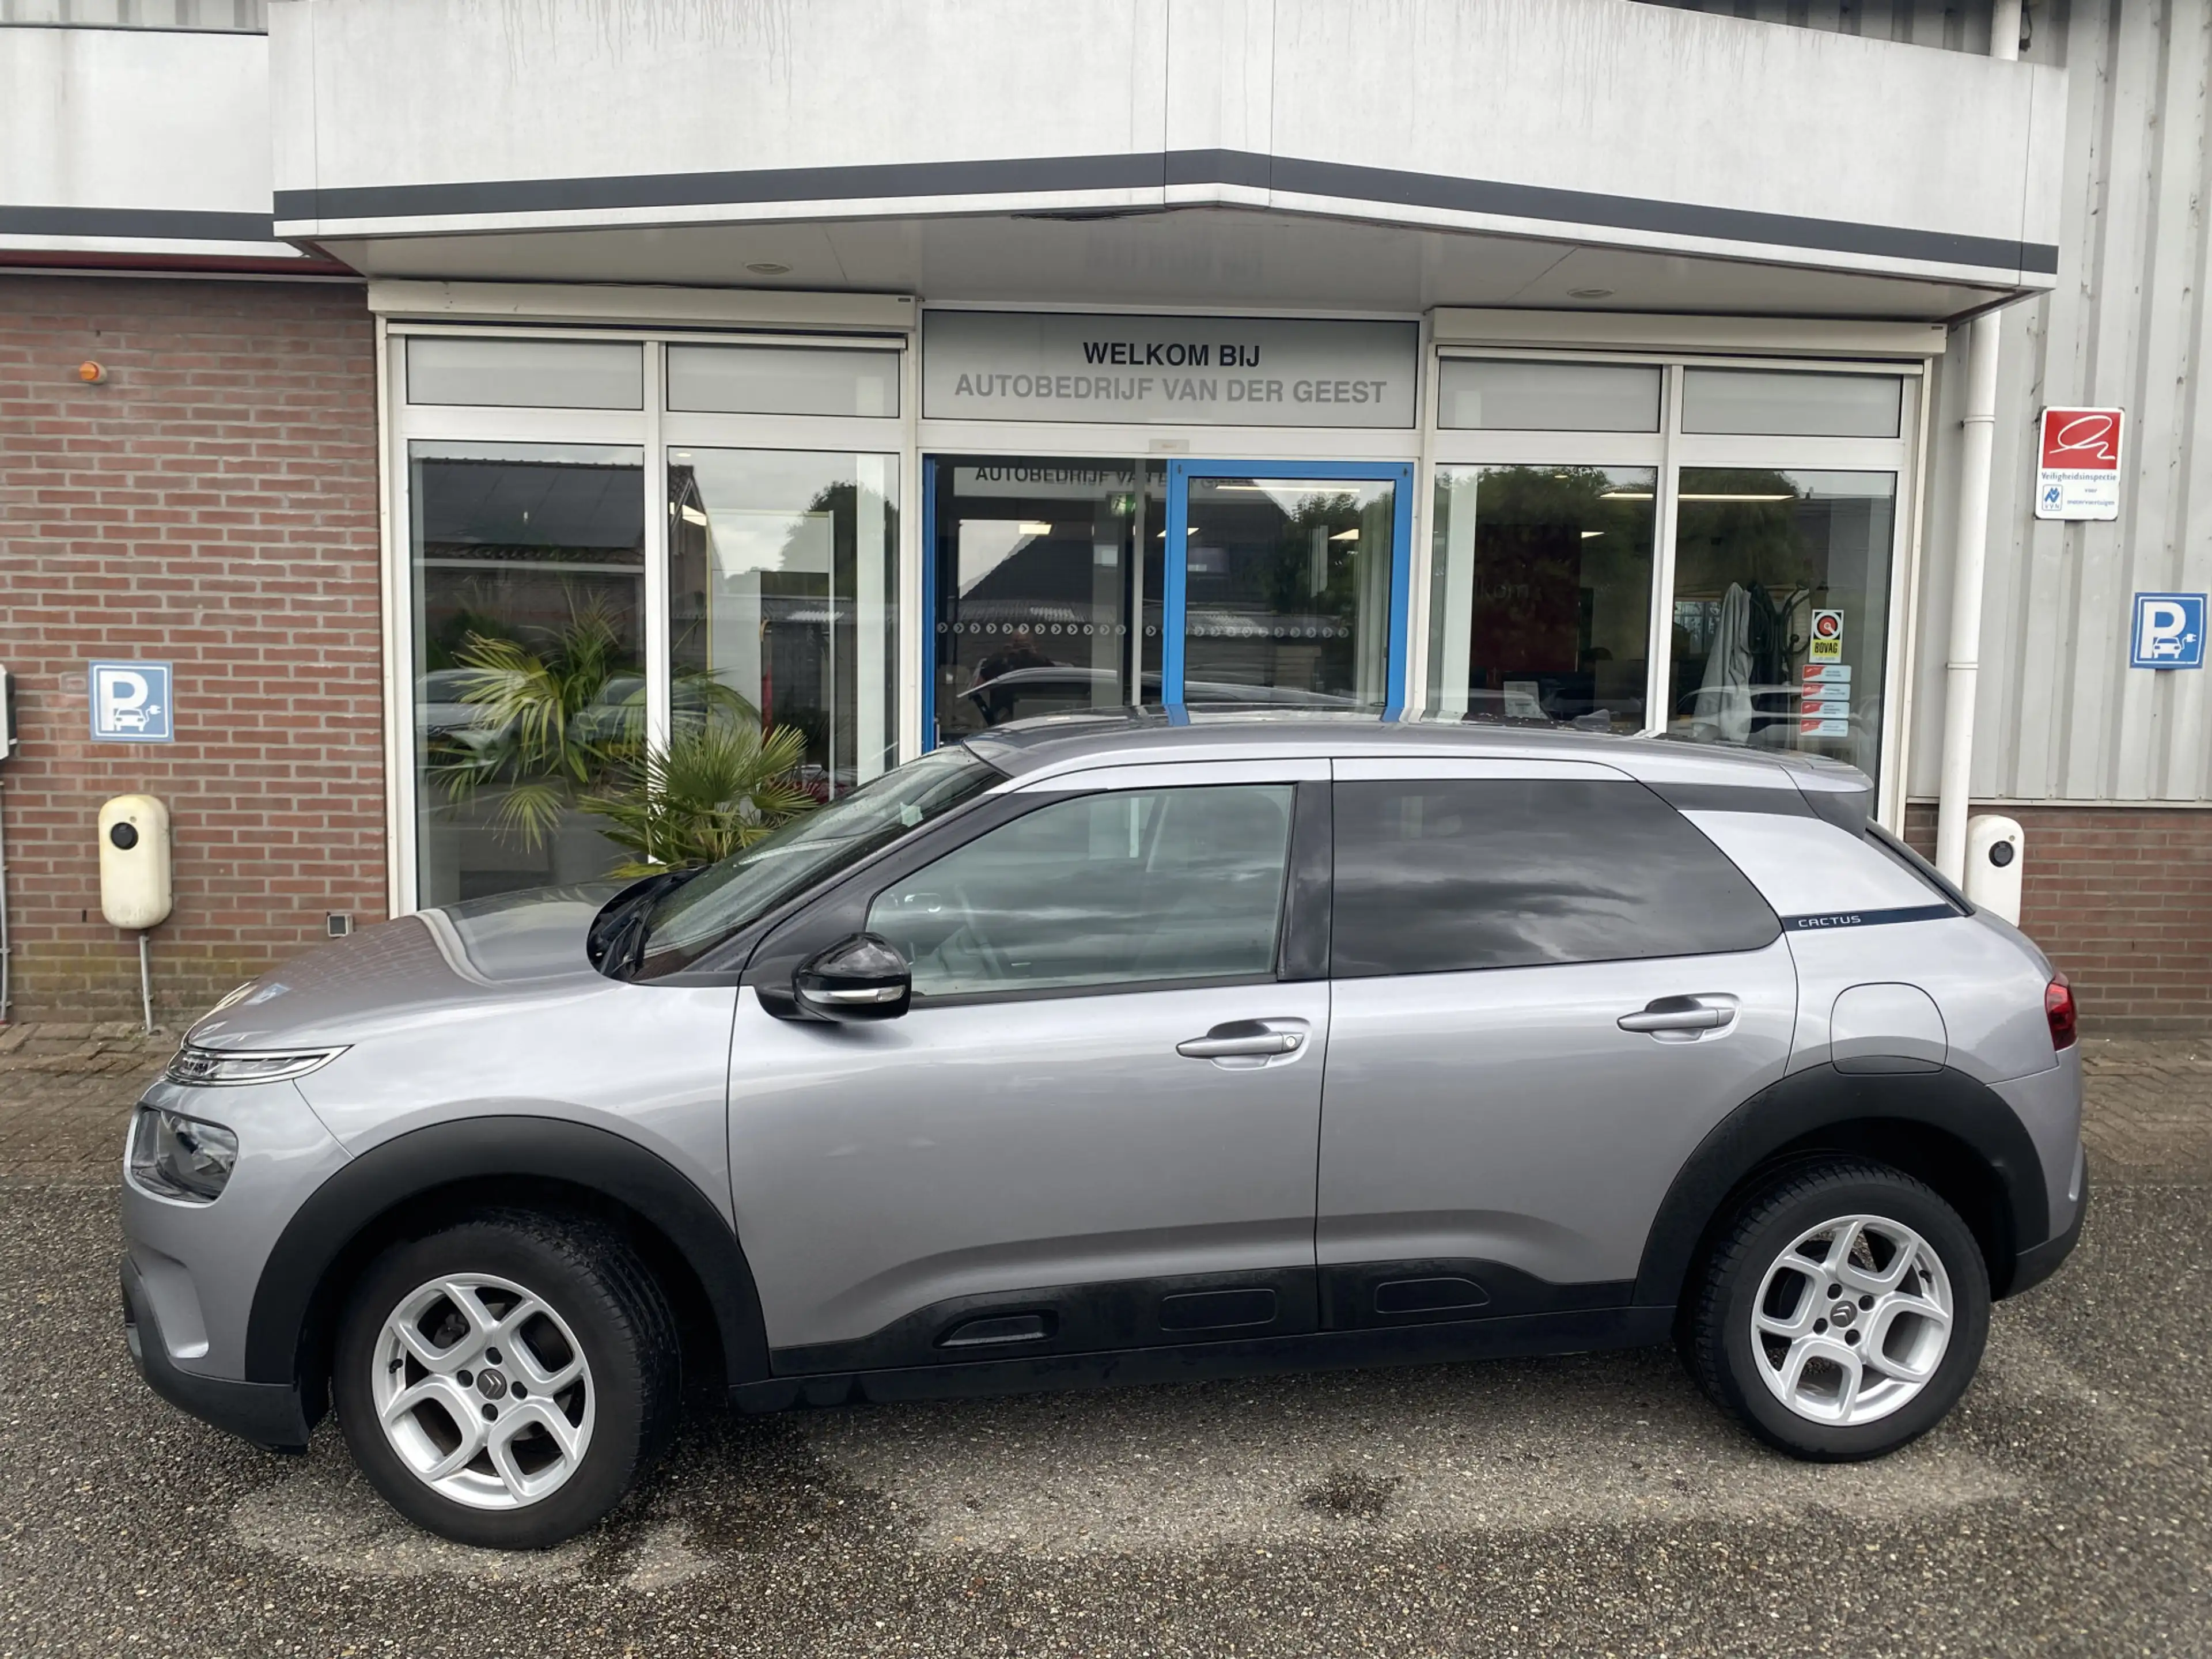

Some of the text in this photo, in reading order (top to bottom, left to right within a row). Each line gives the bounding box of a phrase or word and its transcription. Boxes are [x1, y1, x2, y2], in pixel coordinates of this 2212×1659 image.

[1083, 342, 1260, 367] WELKOM BIJ
[955, 374, 1387, 404] AUTOBEDRIJF VAN DER GEEST
[2041, 472, 2117, 482] Veiligheidsinspectie
[2139, 601, 2186, 658] P
[1815, 642, 1838, 654] BOVAG
[99, 671, 149, 731] P
[1798, 915, 1861, 927] CACTUS
